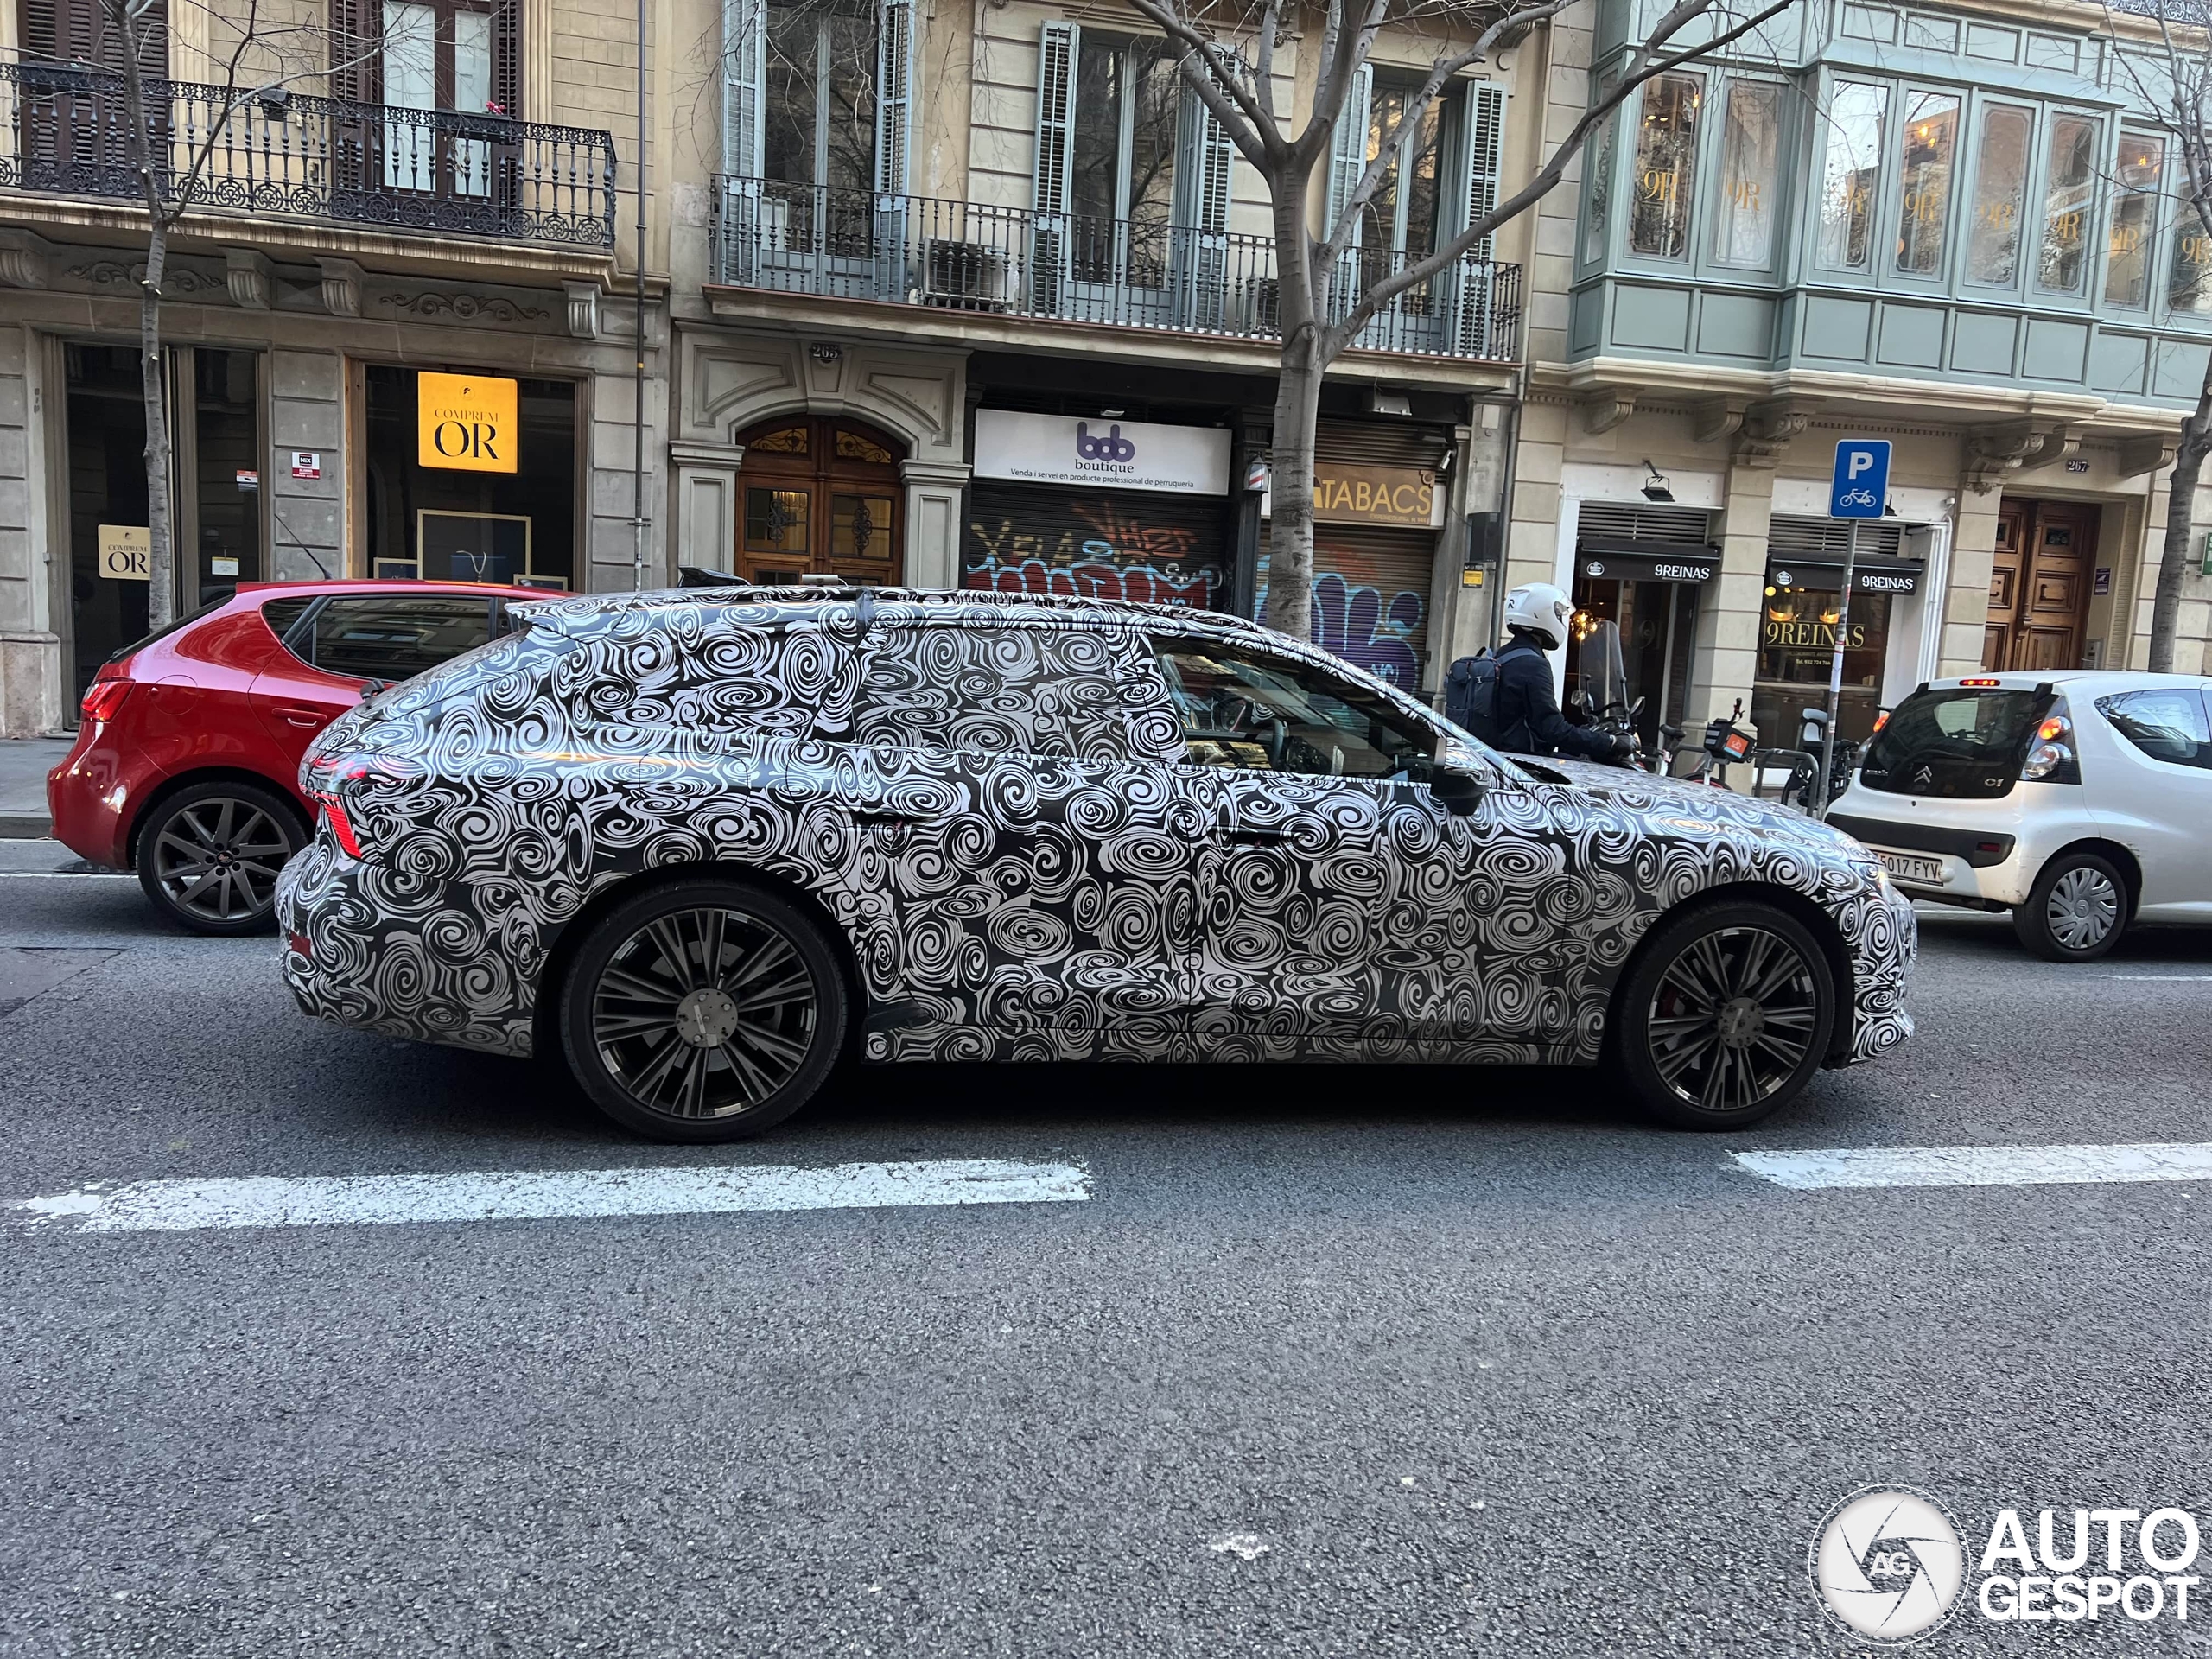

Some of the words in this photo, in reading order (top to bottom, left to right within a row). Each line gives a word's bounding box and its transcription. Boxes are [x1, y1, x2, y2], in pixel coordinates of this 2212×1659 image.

[1643, 170, 1678, 202] 9R
[1904, 191, 1936, 221] 9R
[434, 408, 499, 423] COMPREM
[434, 420, 500, 460] OR
[1077, 421, 1135, 462] bob
[1075, 459, 1135, 474] boutique
[1848, 452, 1873, 480] P
[2068, 461, 2088, 472] 267
[1010, 468, 1033, 477] Venda
[1070, 474, 1102, 483] producte
[1102, 476, 1143, 486] professional
[1154, 480, 1194, 488] perruqueria
[1322, 478, 1432, 515] TABACS
[107, 544, 148, 553] COMPREM
[107, 551, 149, 574] OR
[1654, 564, 1711, 580] 9REINAS
[1861, 576, 1914, 590] 9REINAS
[1984, 778, 2005, 787] C1
[1880, 855, 1910, 874] 5017
[1914, 860, 1938, 880] FYV
